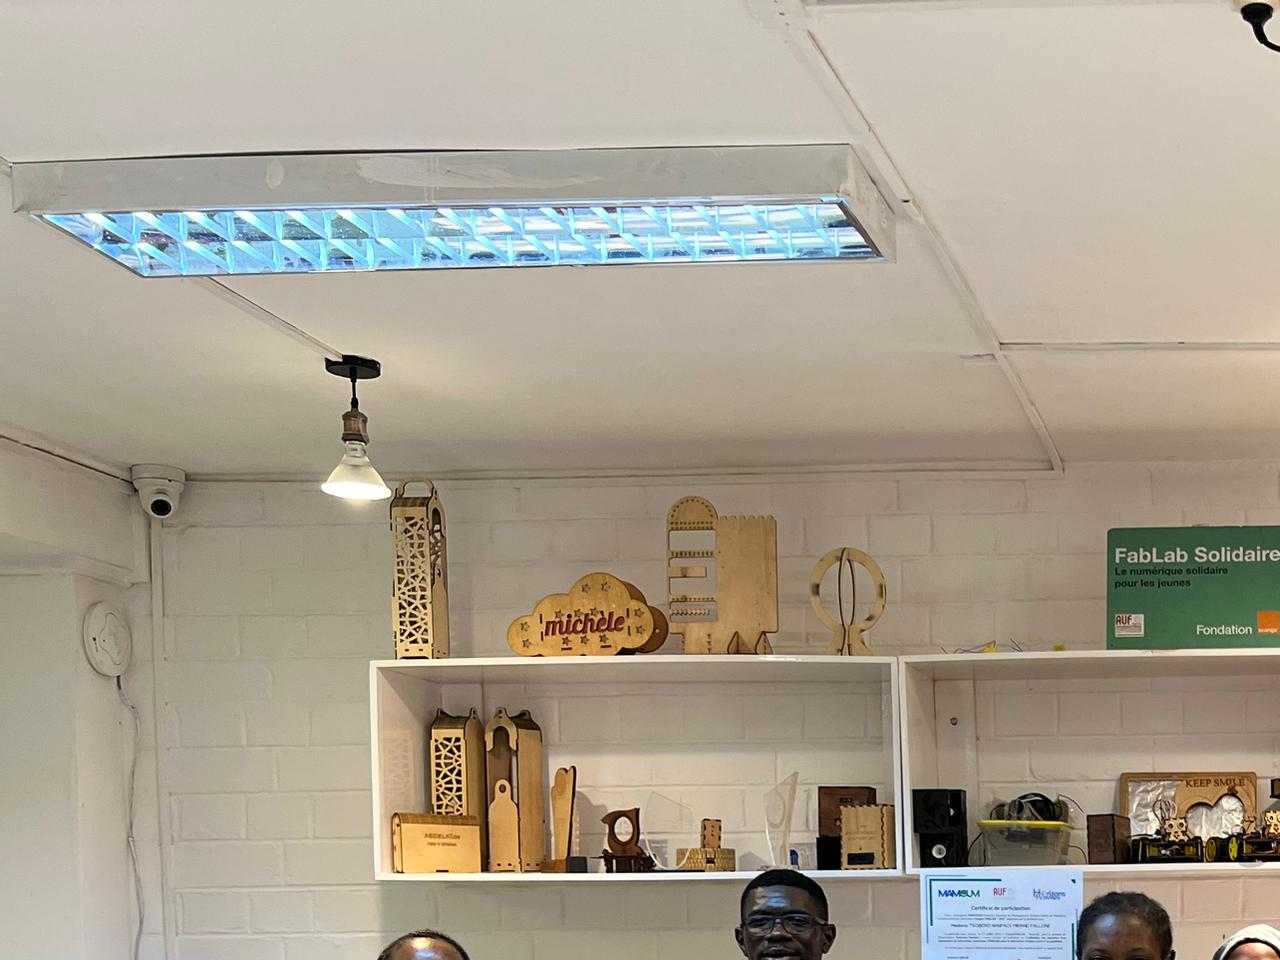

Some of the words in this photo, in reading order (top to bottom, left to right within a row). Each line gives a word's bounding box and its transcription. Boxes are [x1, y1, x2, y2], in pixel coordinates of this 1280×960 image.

[1115, 548, 1188, 563] FabLab
[1195, 546, 1280, 562] Solidaire
[1115, 567, 1127, 576] Le
[1130, 567, 1183, 578] numérique
[1186, 566, 1228, 575] solidaire
[1115, 580, 1137, 589] pour
[1140, 579, 1155, 587] les
[1157, 579, 1191, 588] jeunes
[545, 611, 625, 636] michèle
[1116, 615, 1132, 625] AUF
[1197, 625, 1252, 635] Fondation
[1186, 779, 1211, 788] KEEP
[1214, 778, 1245, 786] SMILE
[993, 888, 1007, 896] AUF
